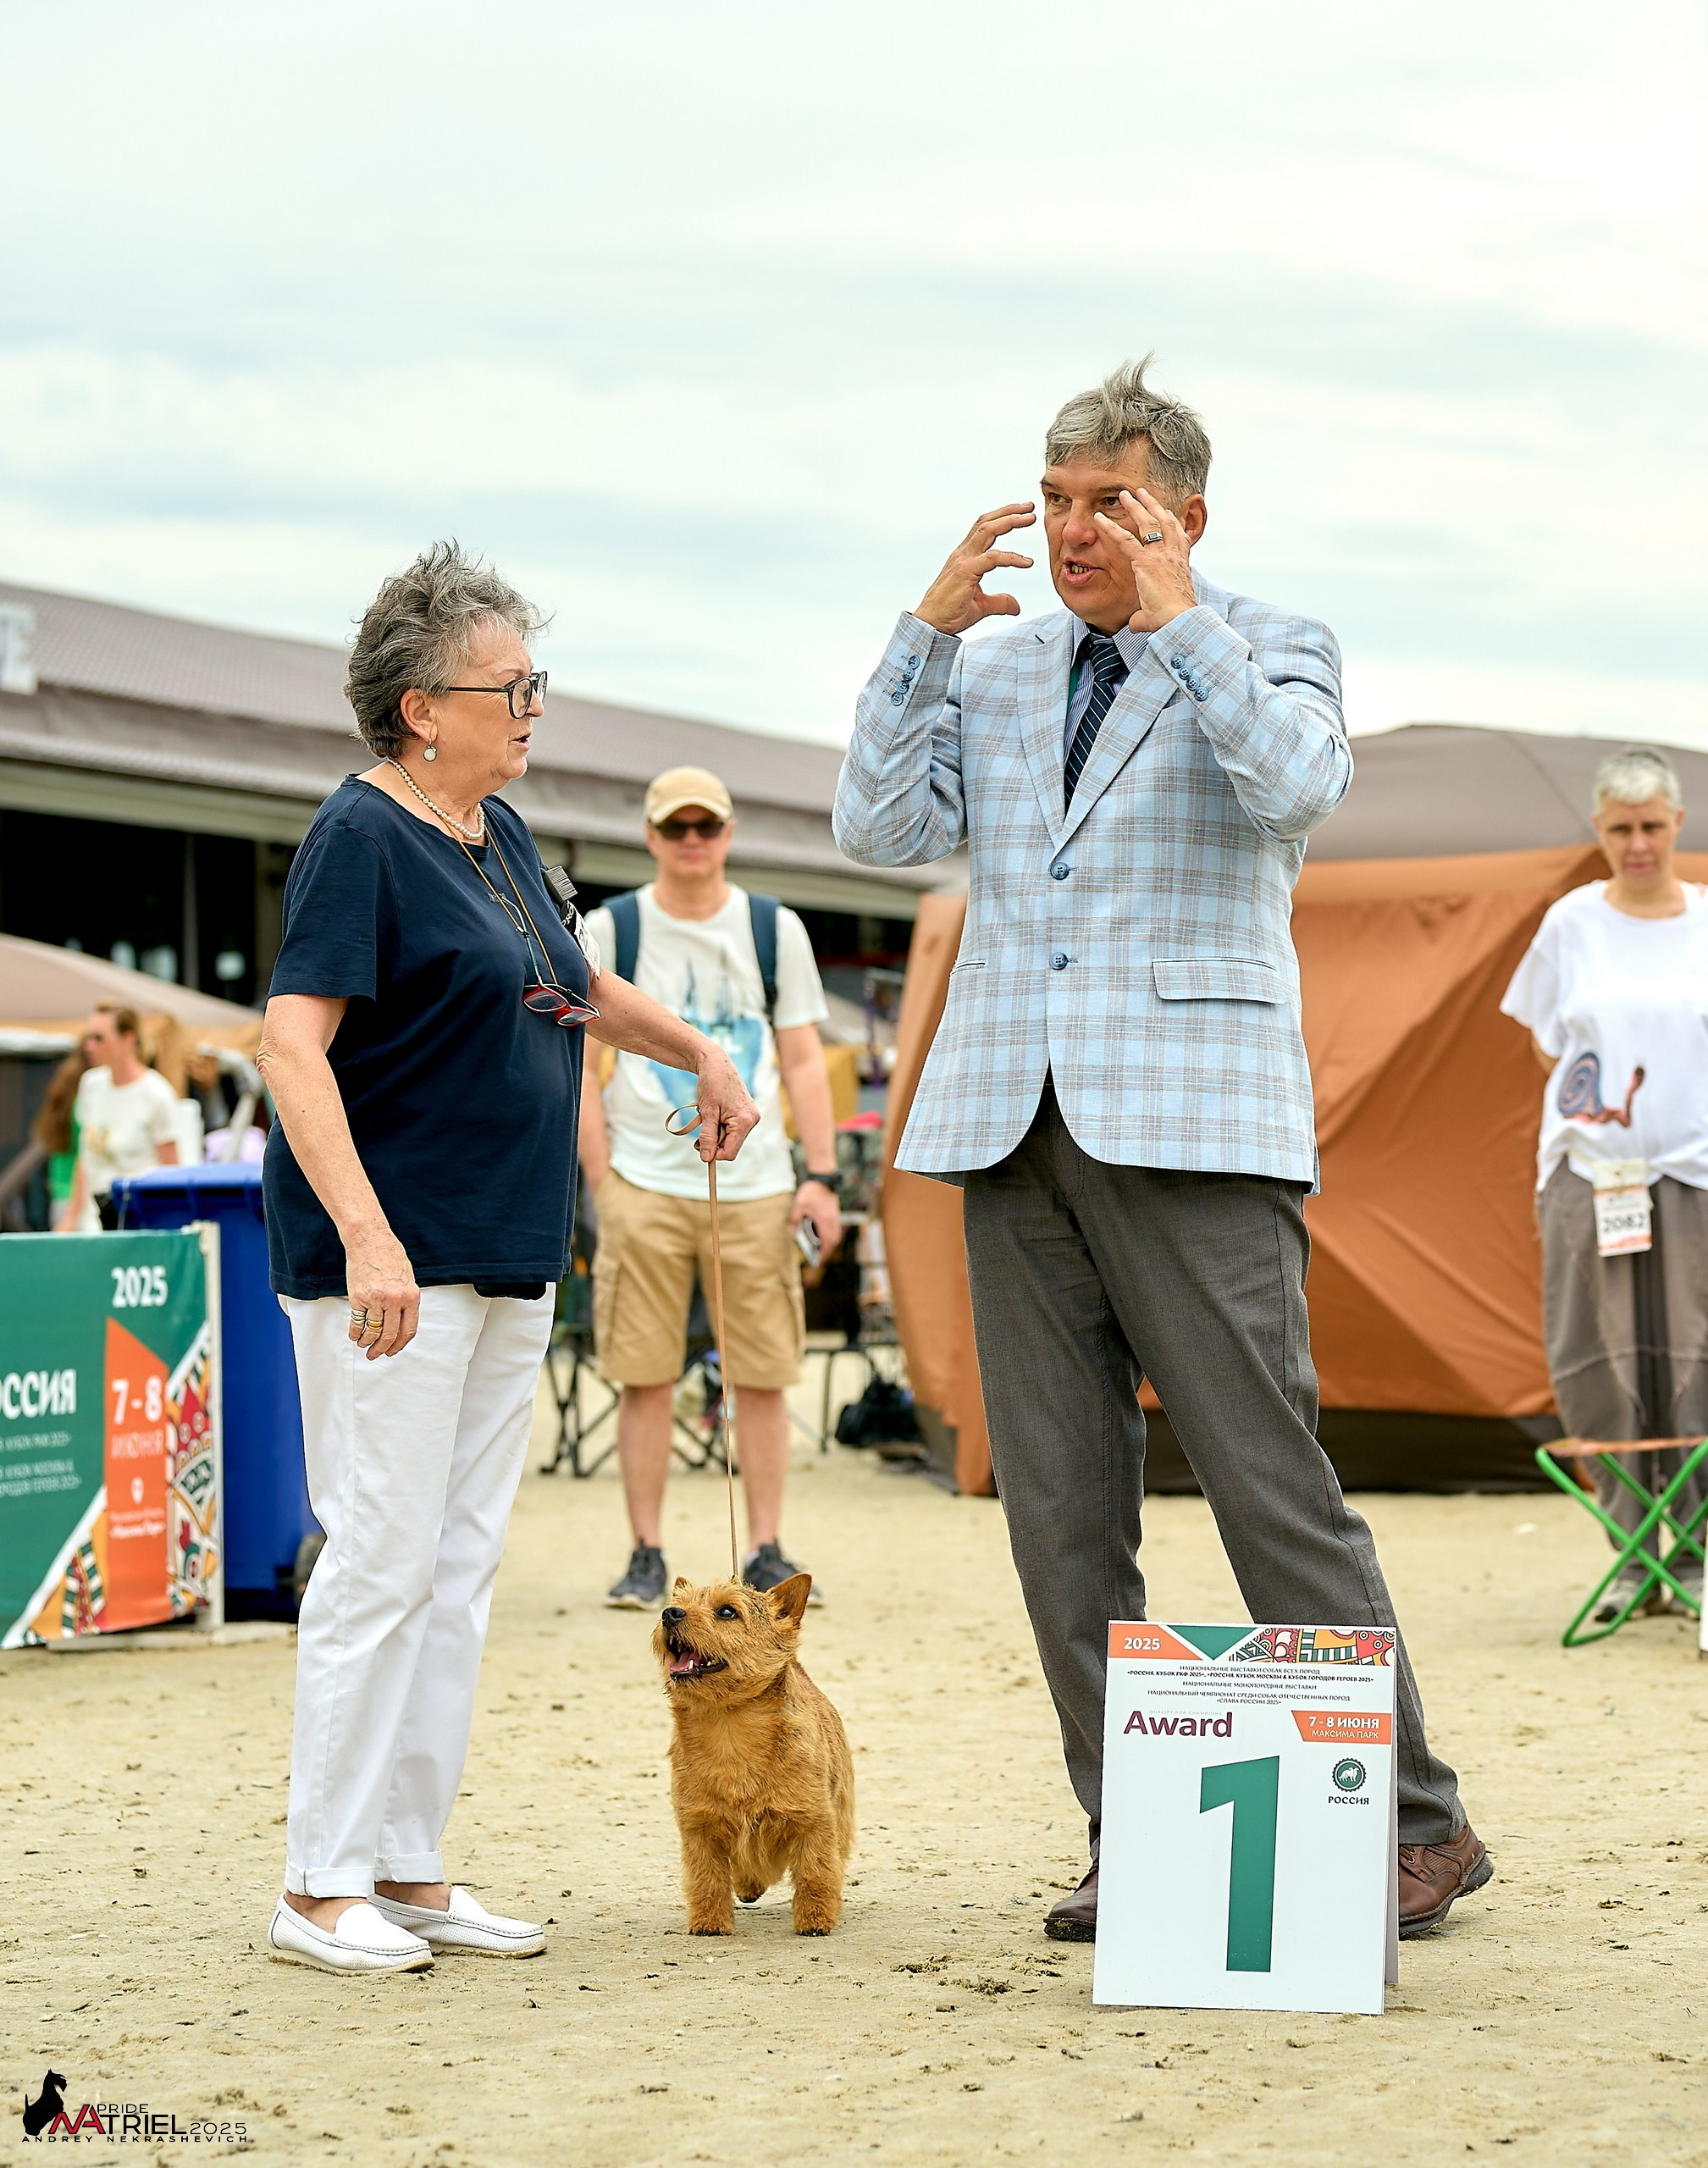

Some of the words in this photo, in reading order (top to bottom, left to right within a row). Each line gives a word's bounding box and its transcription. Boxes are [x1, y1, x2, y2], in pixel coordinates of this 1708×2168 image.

[111, 1265, 168, 1308] 2025
[0, 1369, 77, 1420] ССИЯ
[1124, 1637, 1161, 1650] 2025
[1123, 1710, 1233, 1738] Award
[1308, 1716, 1317, 1727] 7
[1326, 1717, 1335, 1728] 8
[1337, 1717, 1379, 1729] ИЮНЯ
[1312, 1729, 1356, 1739] МАКСИМА
[1357, 1730, 1379, 1739] ПАРК
[1328, 1795, 1369, 1805] РОССИЯ
[1200, 1755, 1280, 1972] 1
